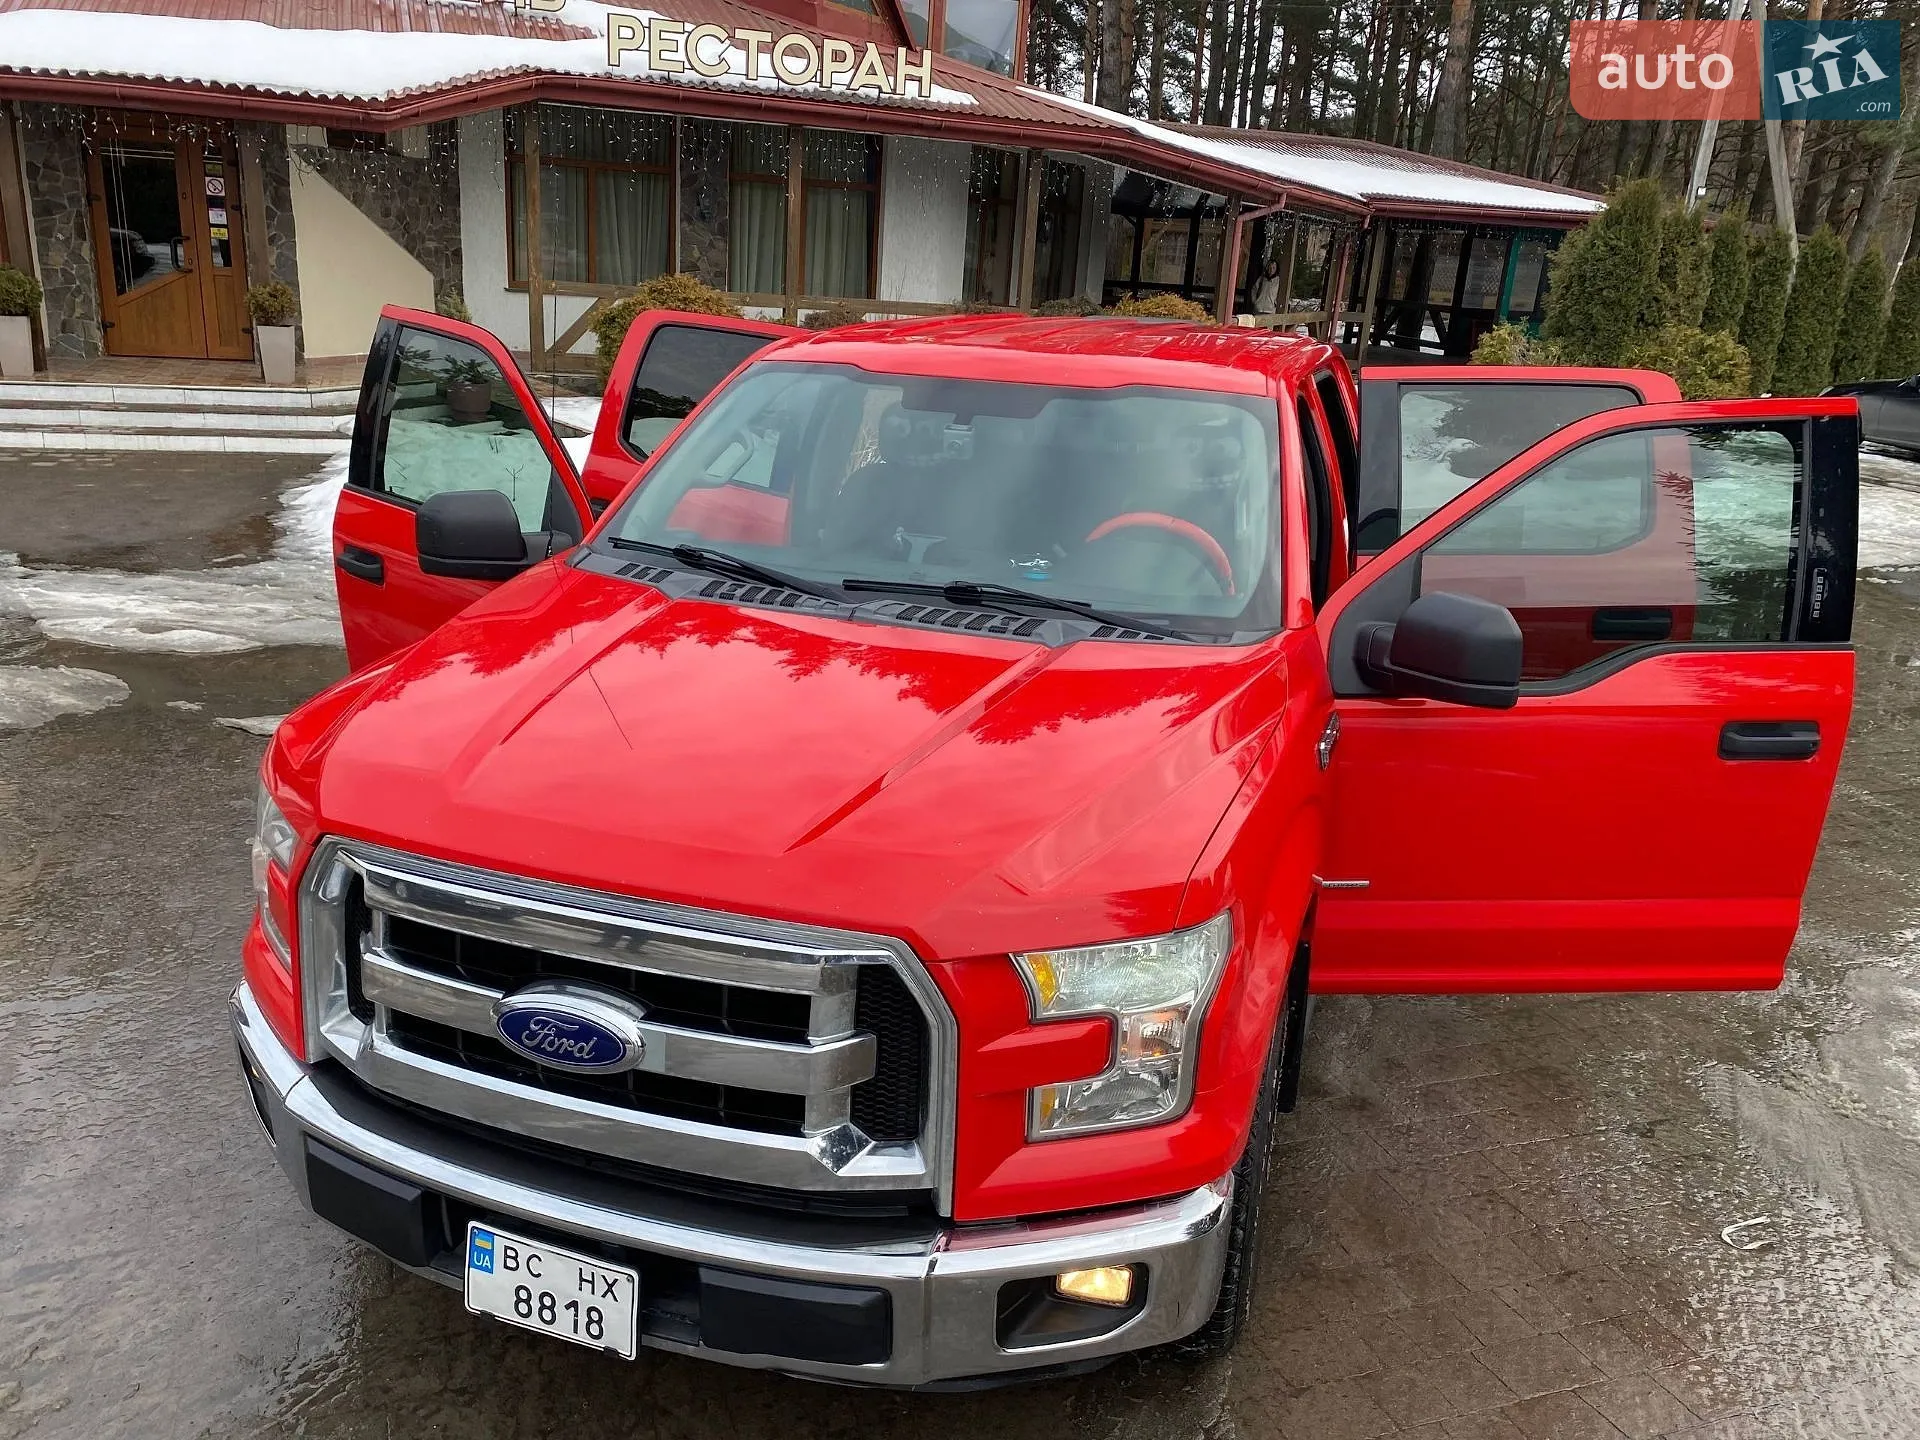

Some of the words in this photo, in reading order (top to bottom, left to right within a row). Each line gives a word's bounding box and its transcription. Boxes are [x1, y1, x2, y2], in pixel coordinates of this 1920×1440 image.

[606, 13, 933, 98] РЕСТОРАН
[521, 1016, 597, 1060] Ford
[474, 1249, 492, 1270] UA
[503, 1244, 543, 1278] BC
[578, 1267, 619, 1302] HX
[514, 1284, 605, 1341] 8818
